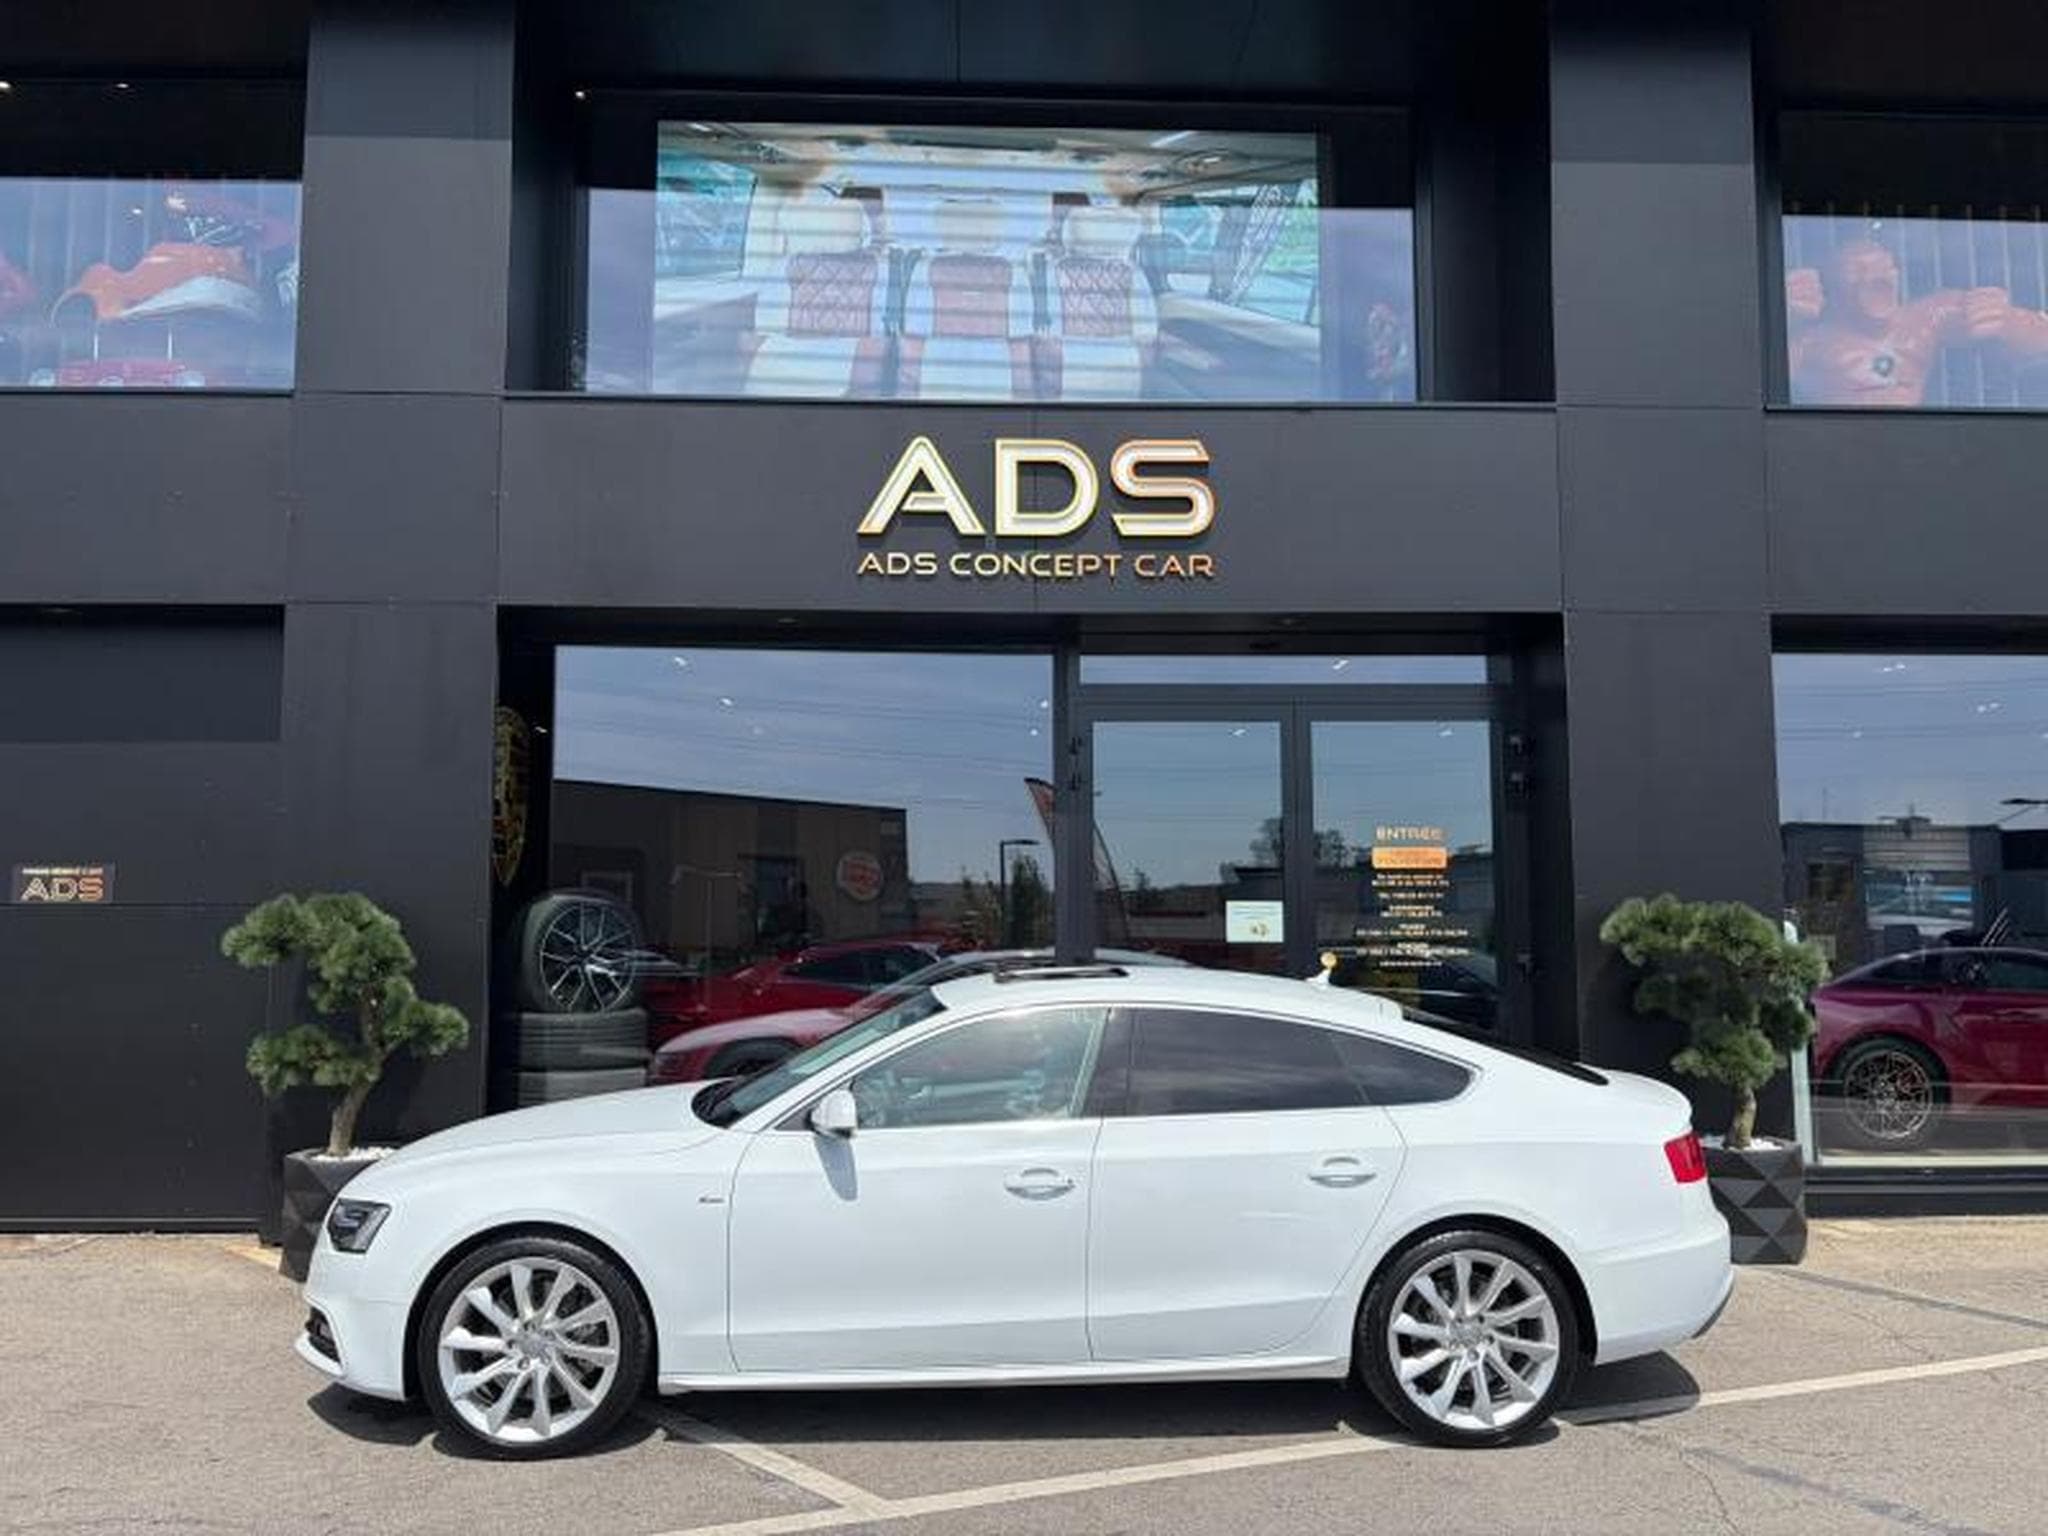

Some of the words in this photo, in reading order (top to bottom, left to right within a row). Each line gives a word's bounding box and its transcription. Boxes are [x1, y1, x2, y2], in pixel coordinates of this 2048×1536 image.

[857, 436, 1215, 537] ADS
[857, 553, 938, 577] ADS
[950, 553, 1123, 577] CONCEPT
[1134, 554, 1215, 577] CAR
[20, 877, 105, 902] ADS
